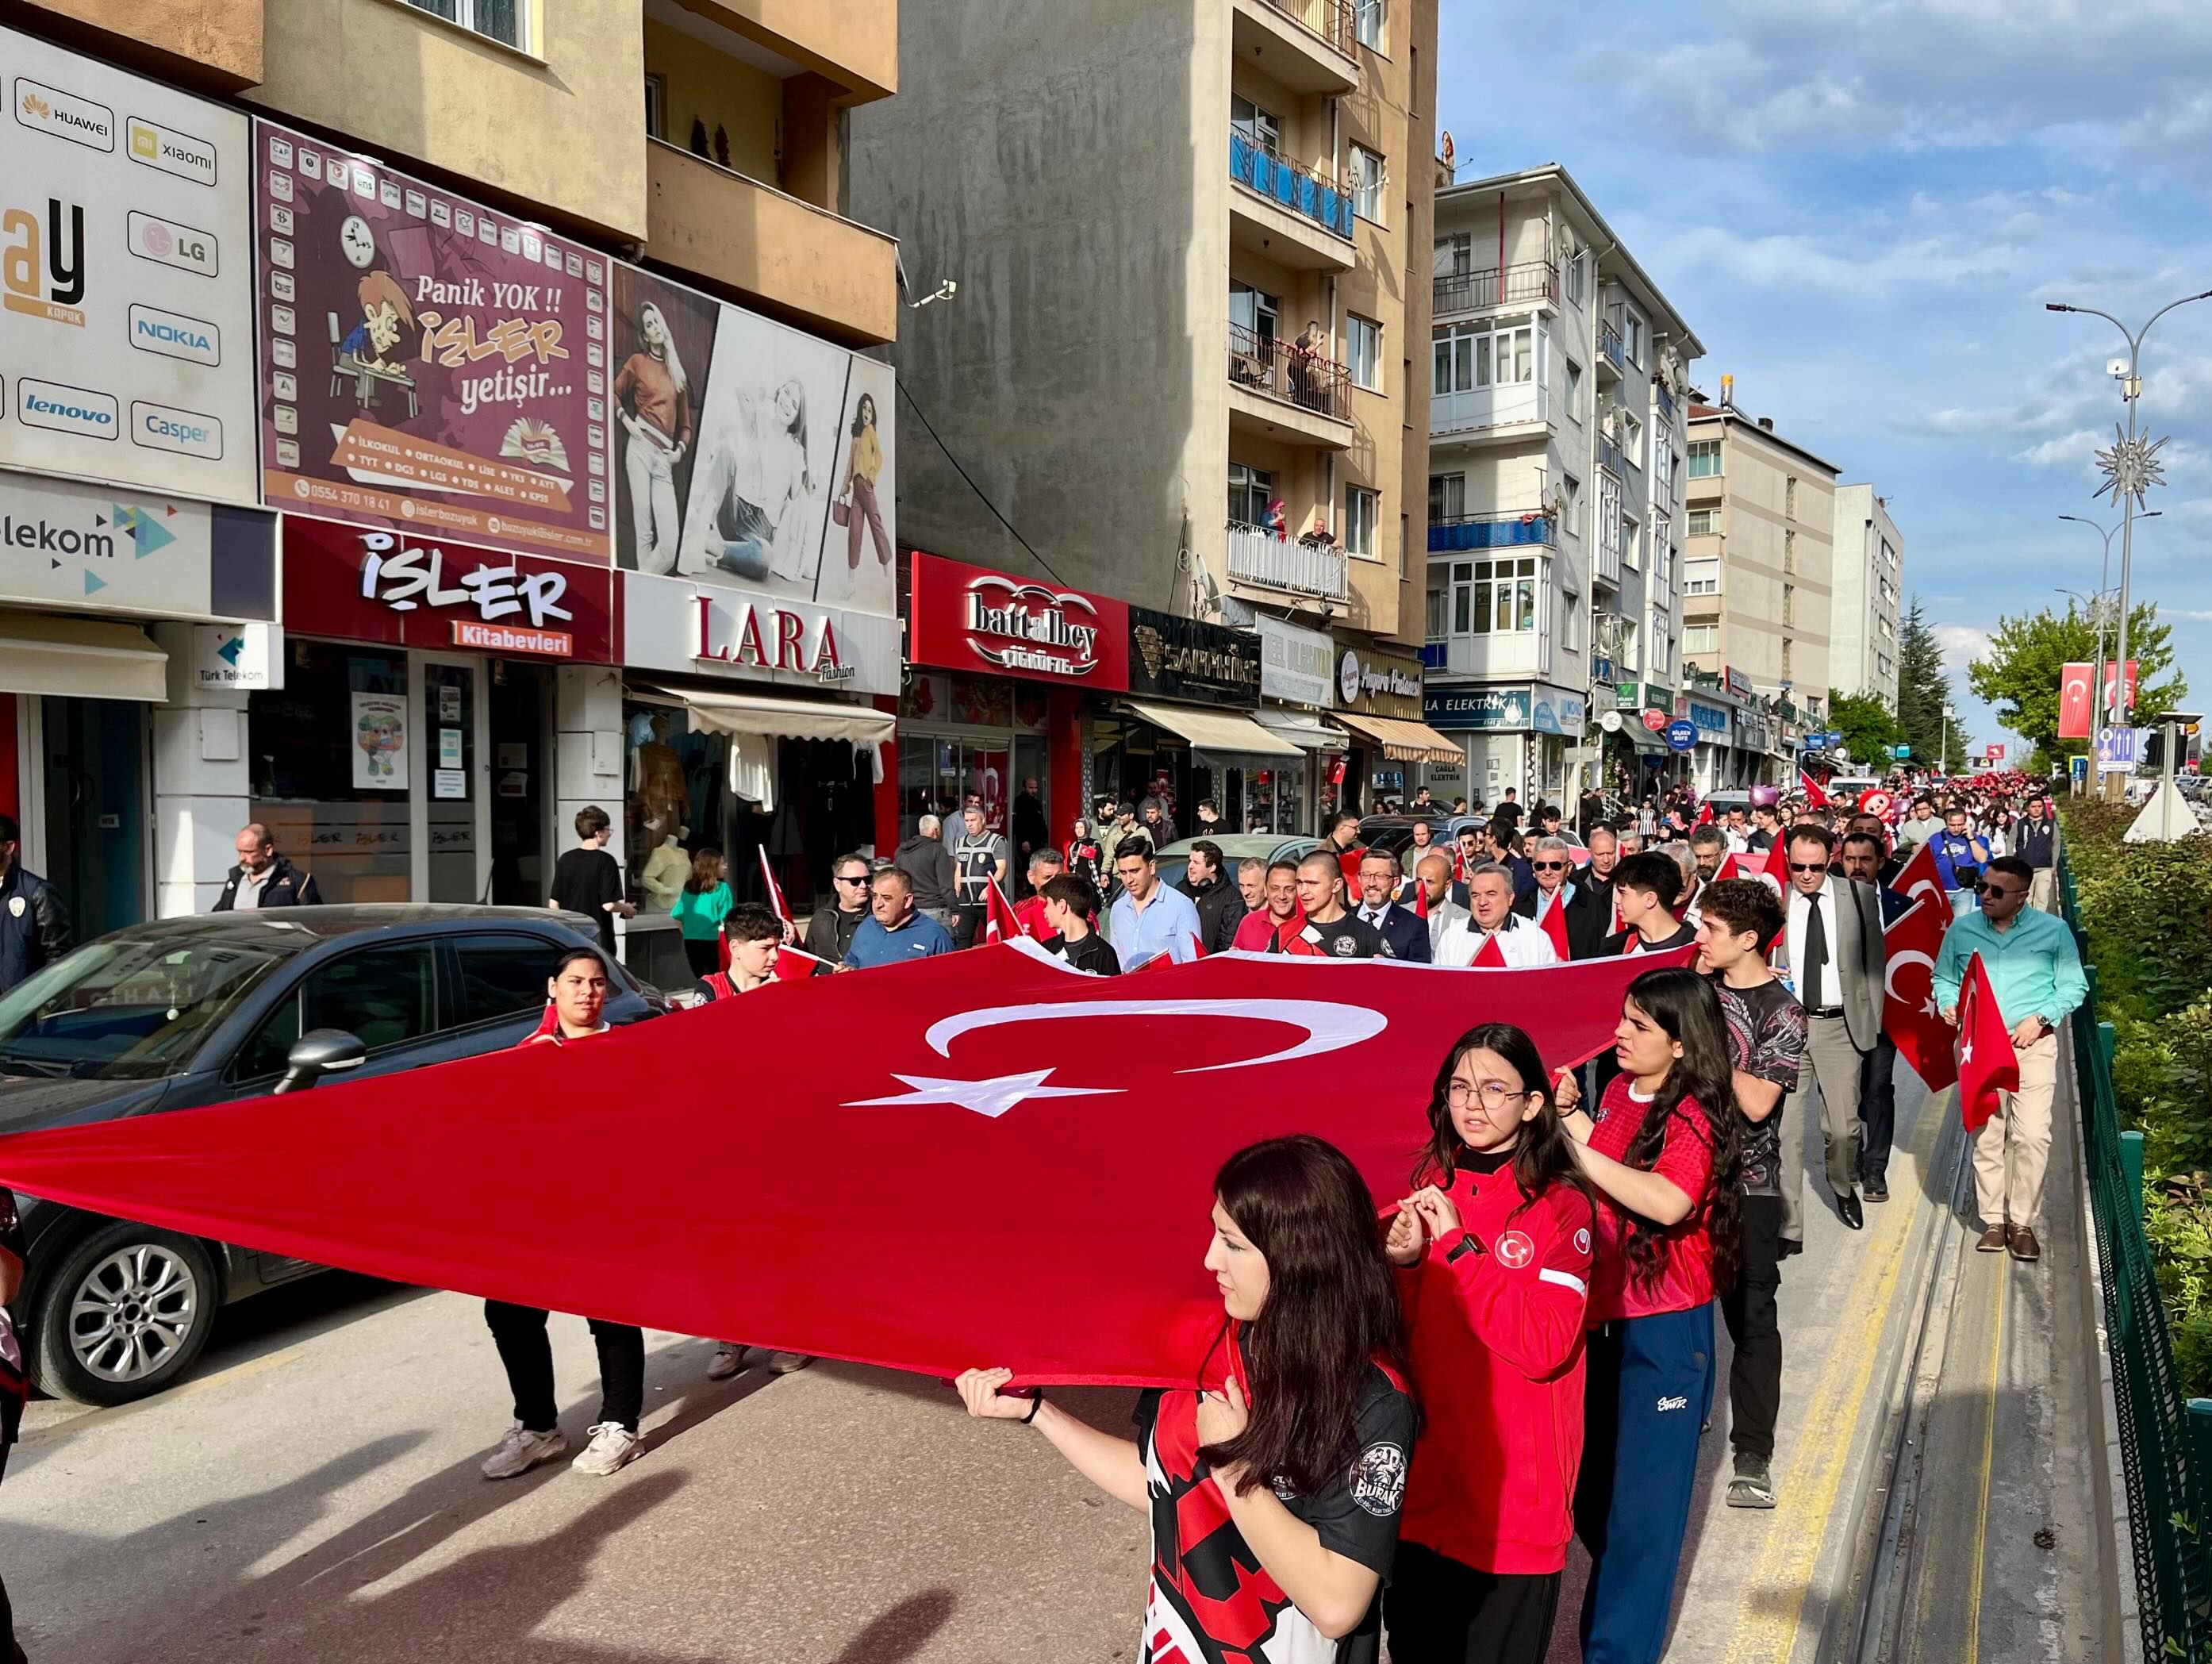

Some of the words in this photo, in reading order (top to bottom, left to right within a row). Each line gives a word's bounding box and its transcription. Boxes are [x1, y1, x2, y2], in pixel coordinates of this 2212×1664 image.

[54, 110, 108, 136] HUAWEI
[179, 238, 205, 262] LG
[416, 275, 485, 307] Panik
[492, 282, 540, 311] YOK
[138, 320, 211, 351] NOKIA
[460, 363, 572, 415] yetişir...
[25, 394, 111, 425] lenovo
[146, 415, 209, 443] Casper
[358, 436, 400, 455] İLKOKUL
[415, 451, 464, 470] ORTAOKUL
[539, 478, 555, 490] AYT
[359, 455, 378, 467] TYT
[394, 463, 415, 475] DGS
[430, 471, 447, 482] LGS
[462, 477, 479, 489] YDS
[493, 483, 515, 496] ALES
[528, 490, 550, 503] KPSS
[311, 484, 339, 501] 0554
[340, 490, 360, 505] 370
[363, 495, 376, 509] 18
[378, 499, 390, 510] 41
[0, 515, 114, 558] lekom
[462, 626, 569, 654] Kitabevleri
[696, 596, 839, 673] LARA
[967, 592, 1097, 660] battalbey
[199, 670, 221, 682] Türk
[223, 670, 263, 681] Telekom
[820, 665, 855, 682] Fashion
[1354, 1477, 1400, 1510] BURAK
